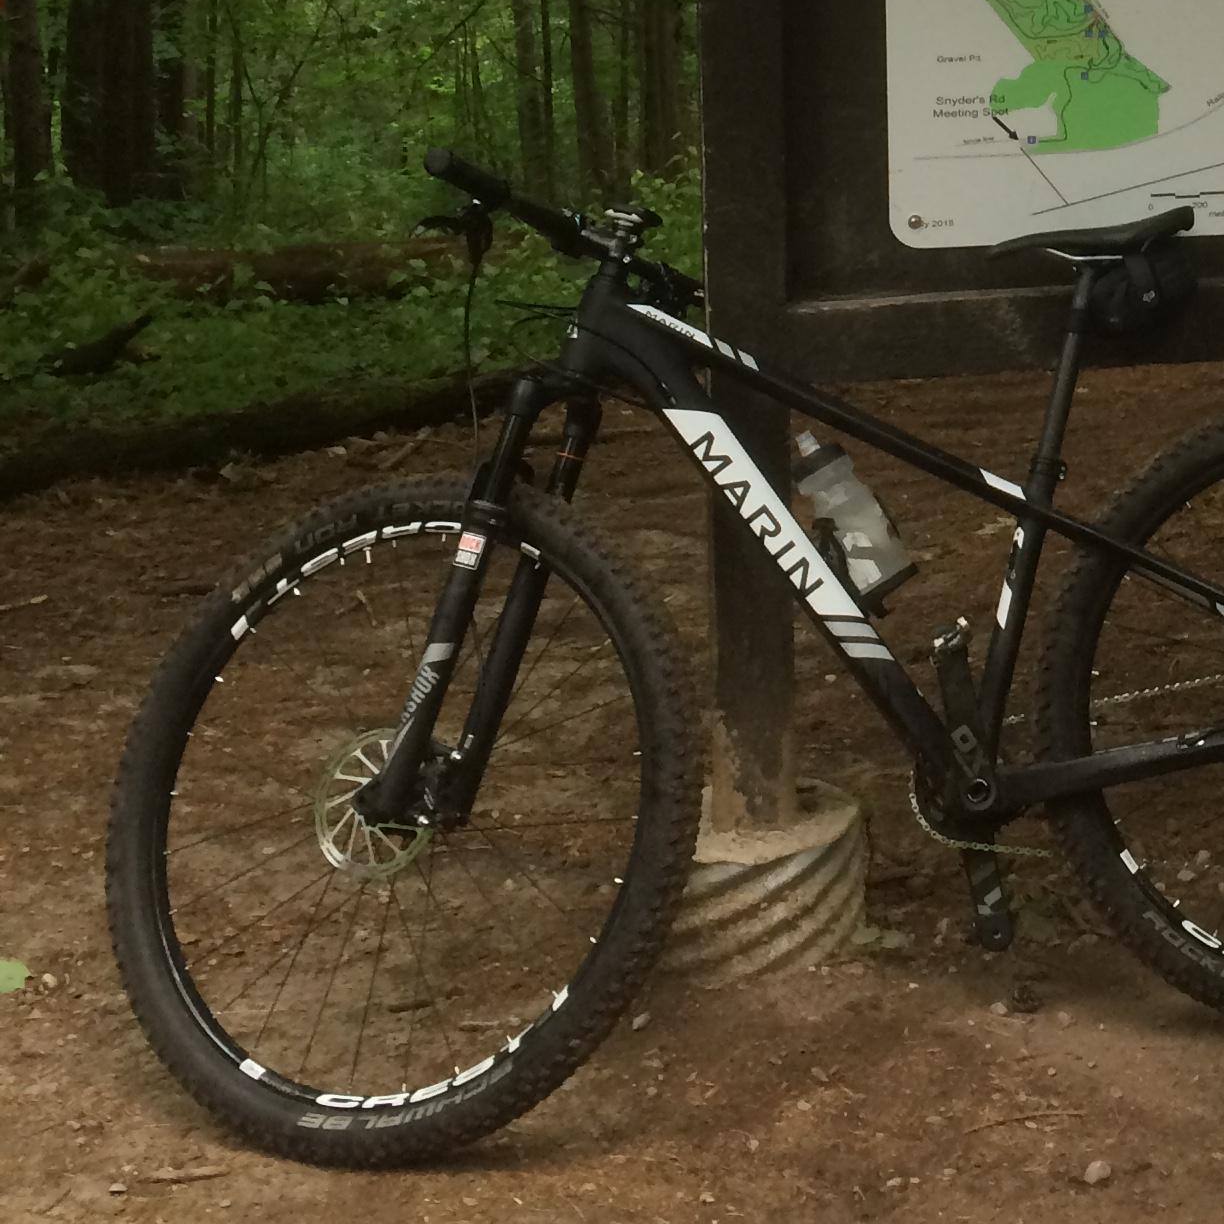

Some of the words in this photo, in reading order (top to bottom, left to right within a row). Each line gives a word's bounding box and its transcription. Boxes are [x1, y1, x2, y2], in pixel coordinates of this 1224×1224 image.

[936, 55, 966, 63] Gravel
[969, 54, 981, 62] Pit
[936, 95, 985, 107] Snyder's
[990, 94, 1005, 104] Rd
[933, 109, 978, 119] Meeting
[983, 107, 1009, 118] Spot
[645, 310, 697, 339] MARIN
[689, 431, 825, 599] MARIN
